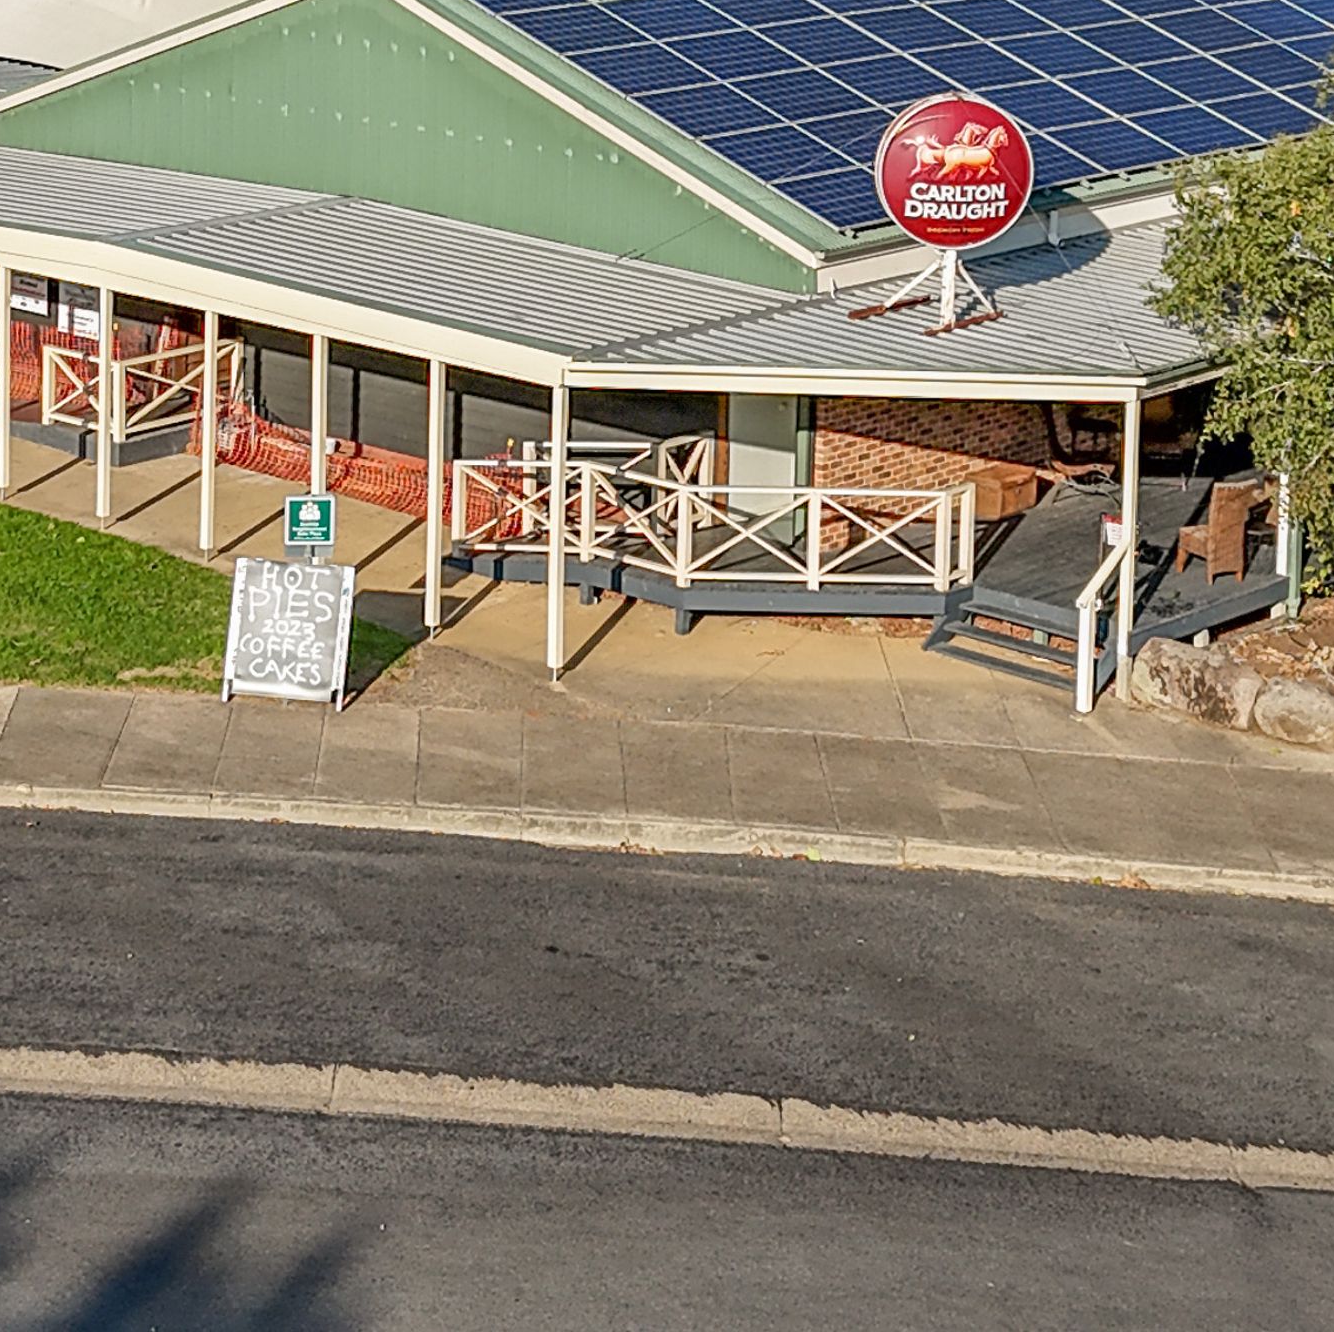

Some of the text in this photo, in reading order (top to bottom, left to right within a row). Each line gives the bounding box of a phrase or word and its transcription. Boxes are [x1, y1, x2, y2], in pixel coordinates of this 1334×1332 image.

[910, 183, 1005, 202] CARLTON
[904, 200, 1009, 219] DRAUGHT
[261, 561, 332, 590] HOT
[248, 586, 336, 623] PIES
[261, 618, 316, 642] 2023
[239, 633, 326, 660] COFFEE
[248, 657, 321, 686] CAKES
